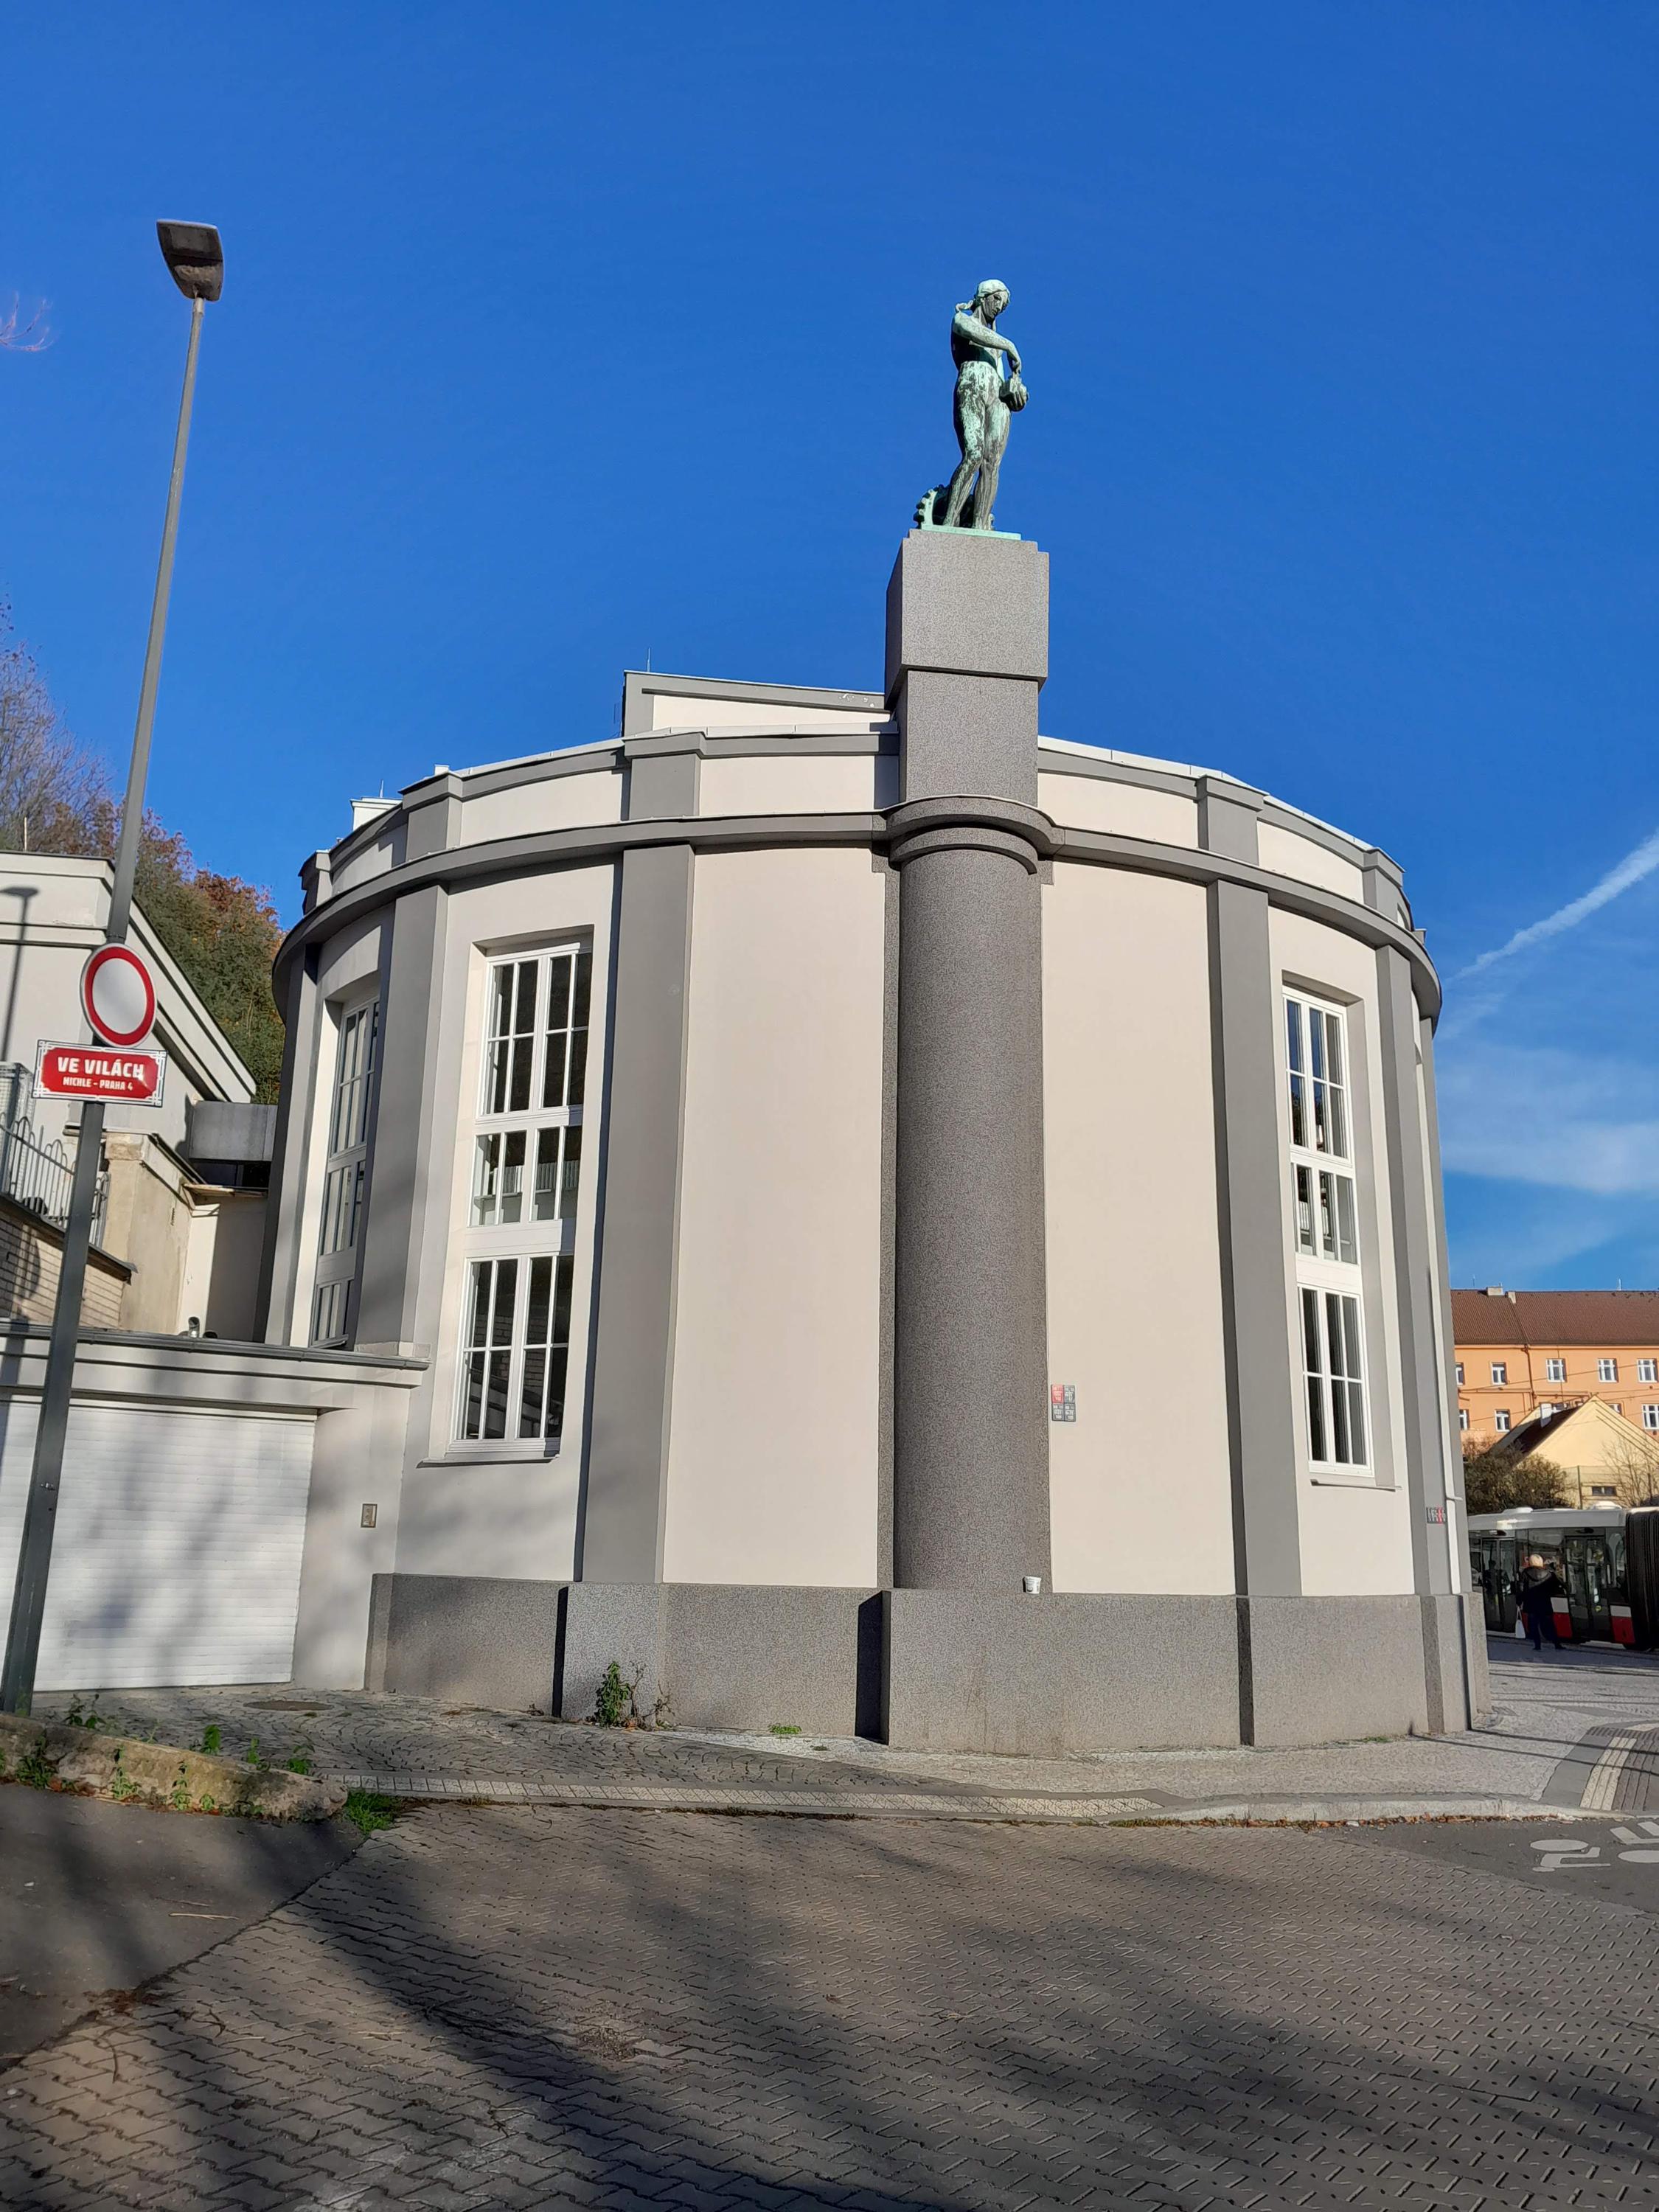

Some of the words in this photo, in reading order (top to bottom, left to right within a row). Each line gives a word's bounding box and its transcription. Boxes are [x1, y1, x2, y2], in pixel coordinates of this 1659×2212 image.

[58, 1057, 80, 1073] VE
[85, 1059, 145, 1078] VILÁCH
[63, 1077, 91, 1088] MICHLE
[100, 1079, 125, 1091] PRAHA
